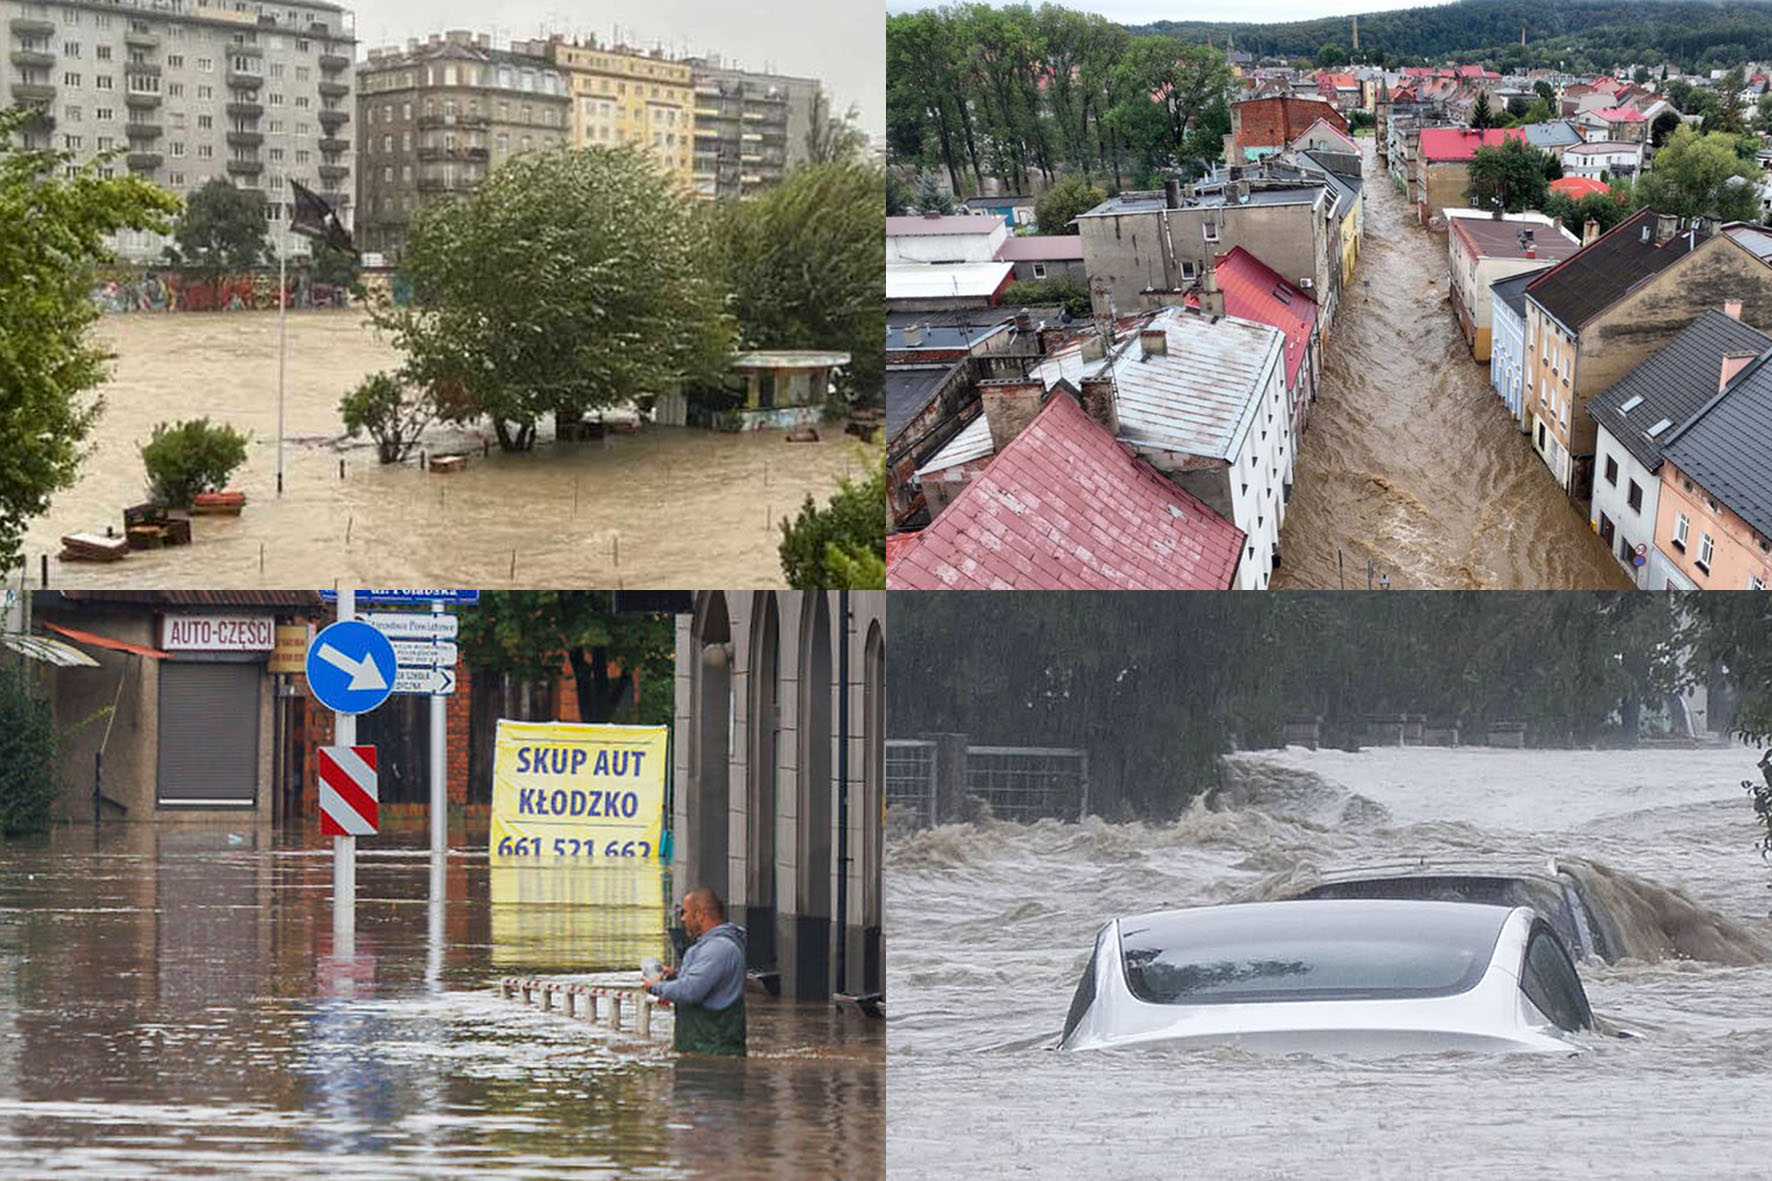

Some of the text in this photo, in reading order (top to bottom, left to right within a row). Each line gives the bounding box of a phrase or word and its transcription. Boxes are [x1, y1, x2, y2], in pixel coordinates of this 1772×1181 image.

[170, 618, 272, 648] AUTO-CZĘŚCI
[516, 747, 646, 777] SKUP AUT
[518, 788, 639, 818] KŁODZKO
[498, 835, 542, 857] 661
[553, 838, 594, 857] 521
